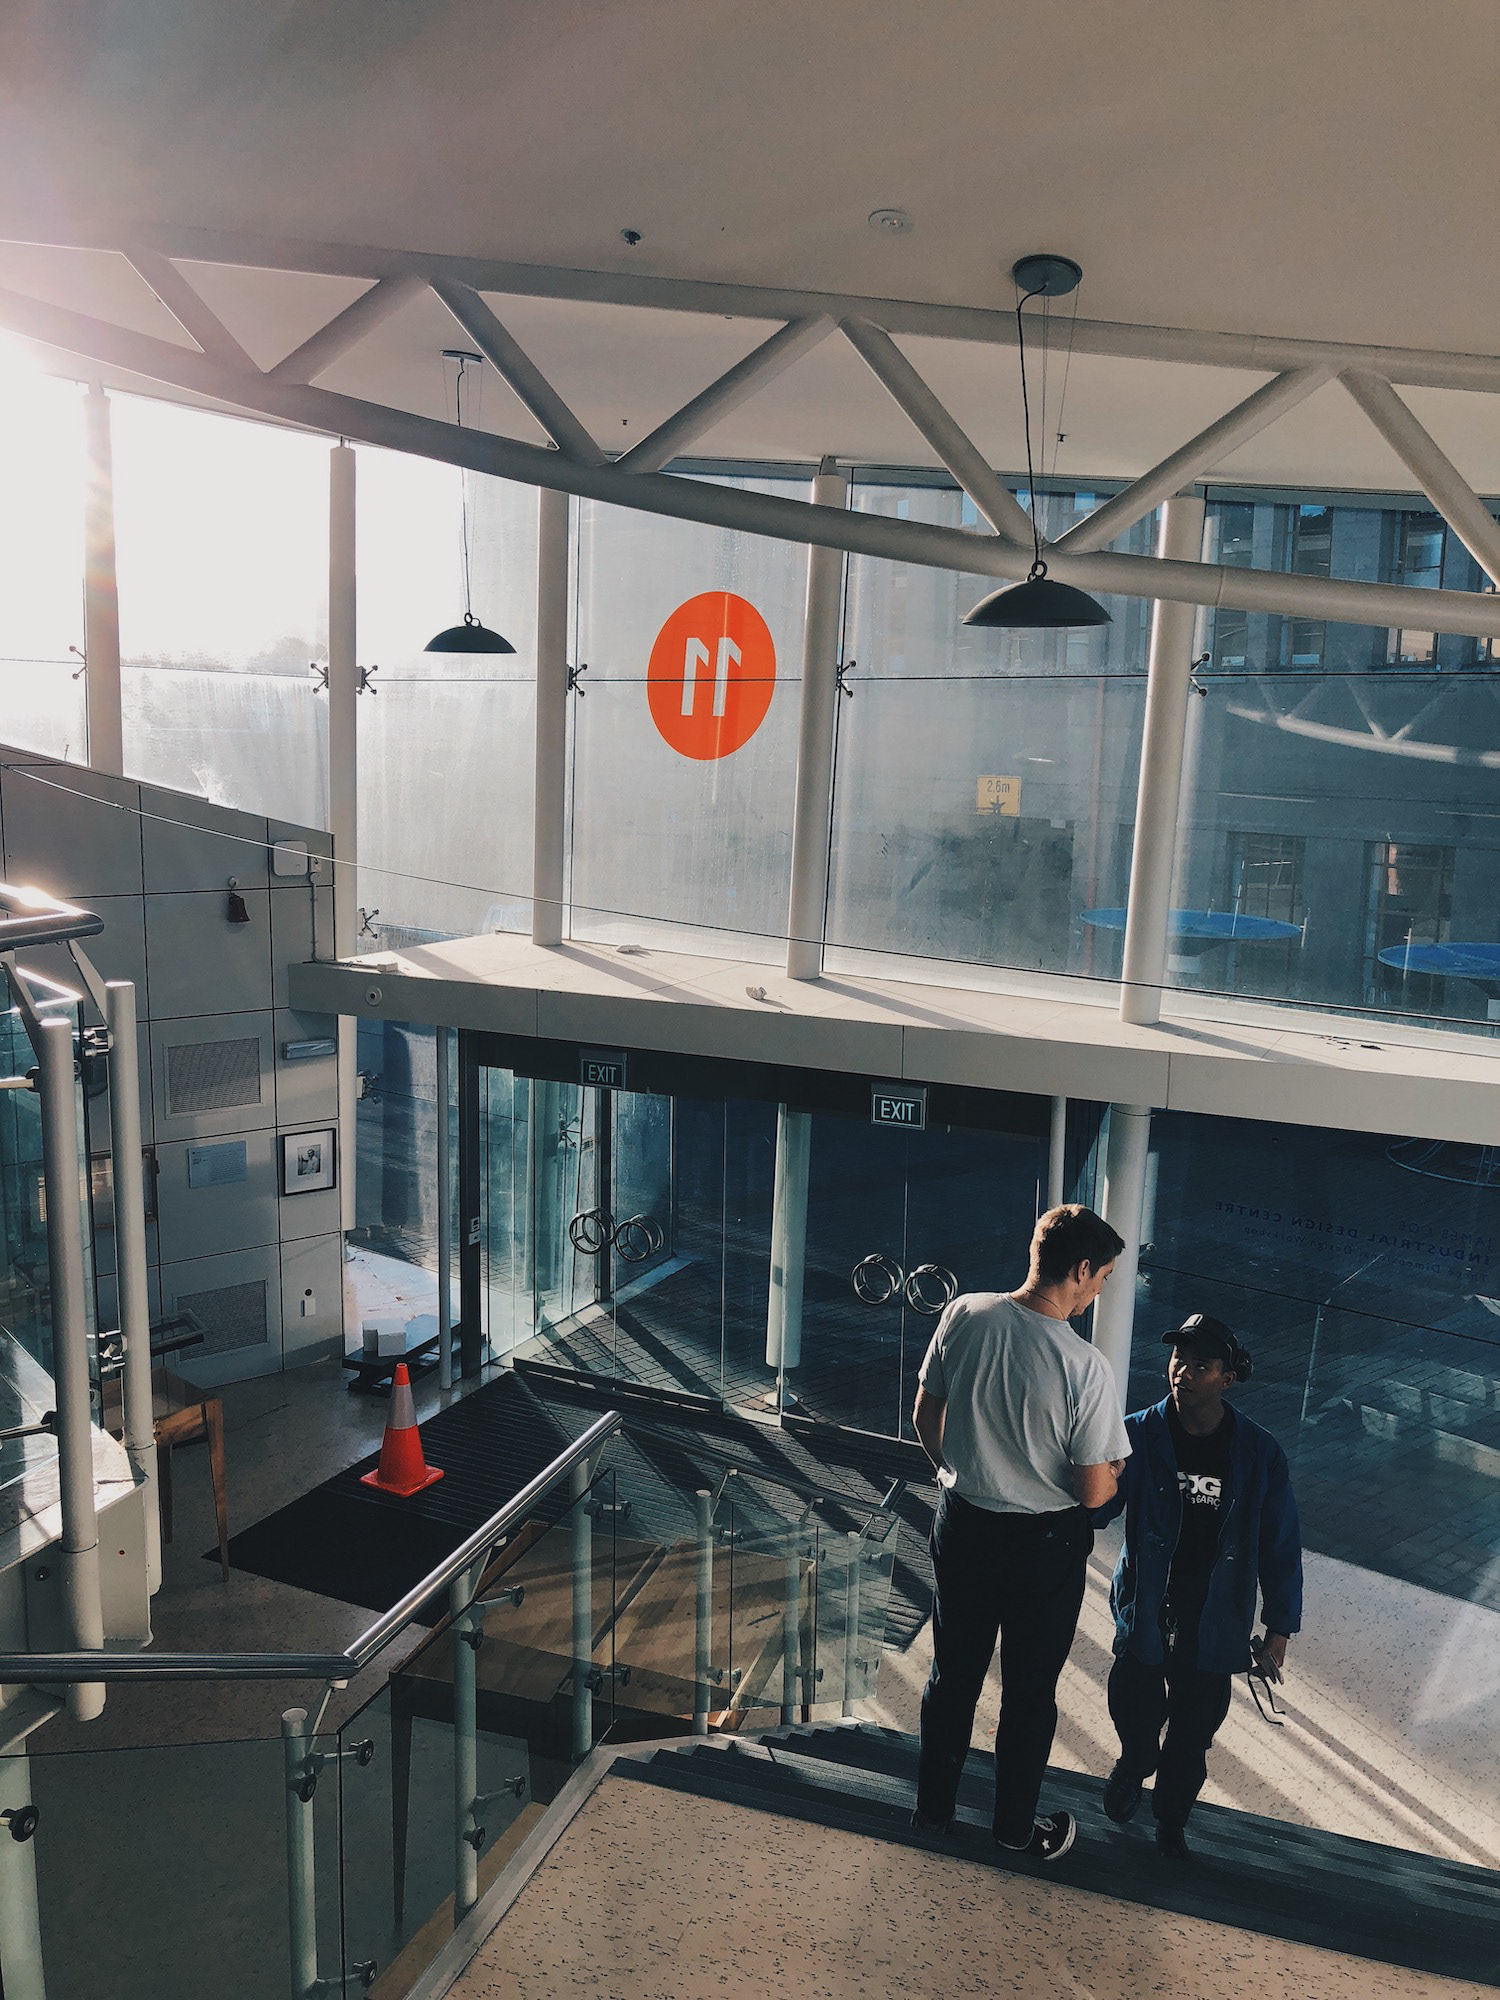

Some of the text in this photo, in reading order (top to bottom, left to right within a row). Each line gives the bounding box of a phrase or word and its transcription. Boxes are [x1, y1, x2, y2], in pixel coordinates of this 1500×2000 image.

[986, 779, 1010, 794] 2.6m
[588, 1064, 617, 1084] EXIT
[880, 1099, 915, 1121] EXIT
